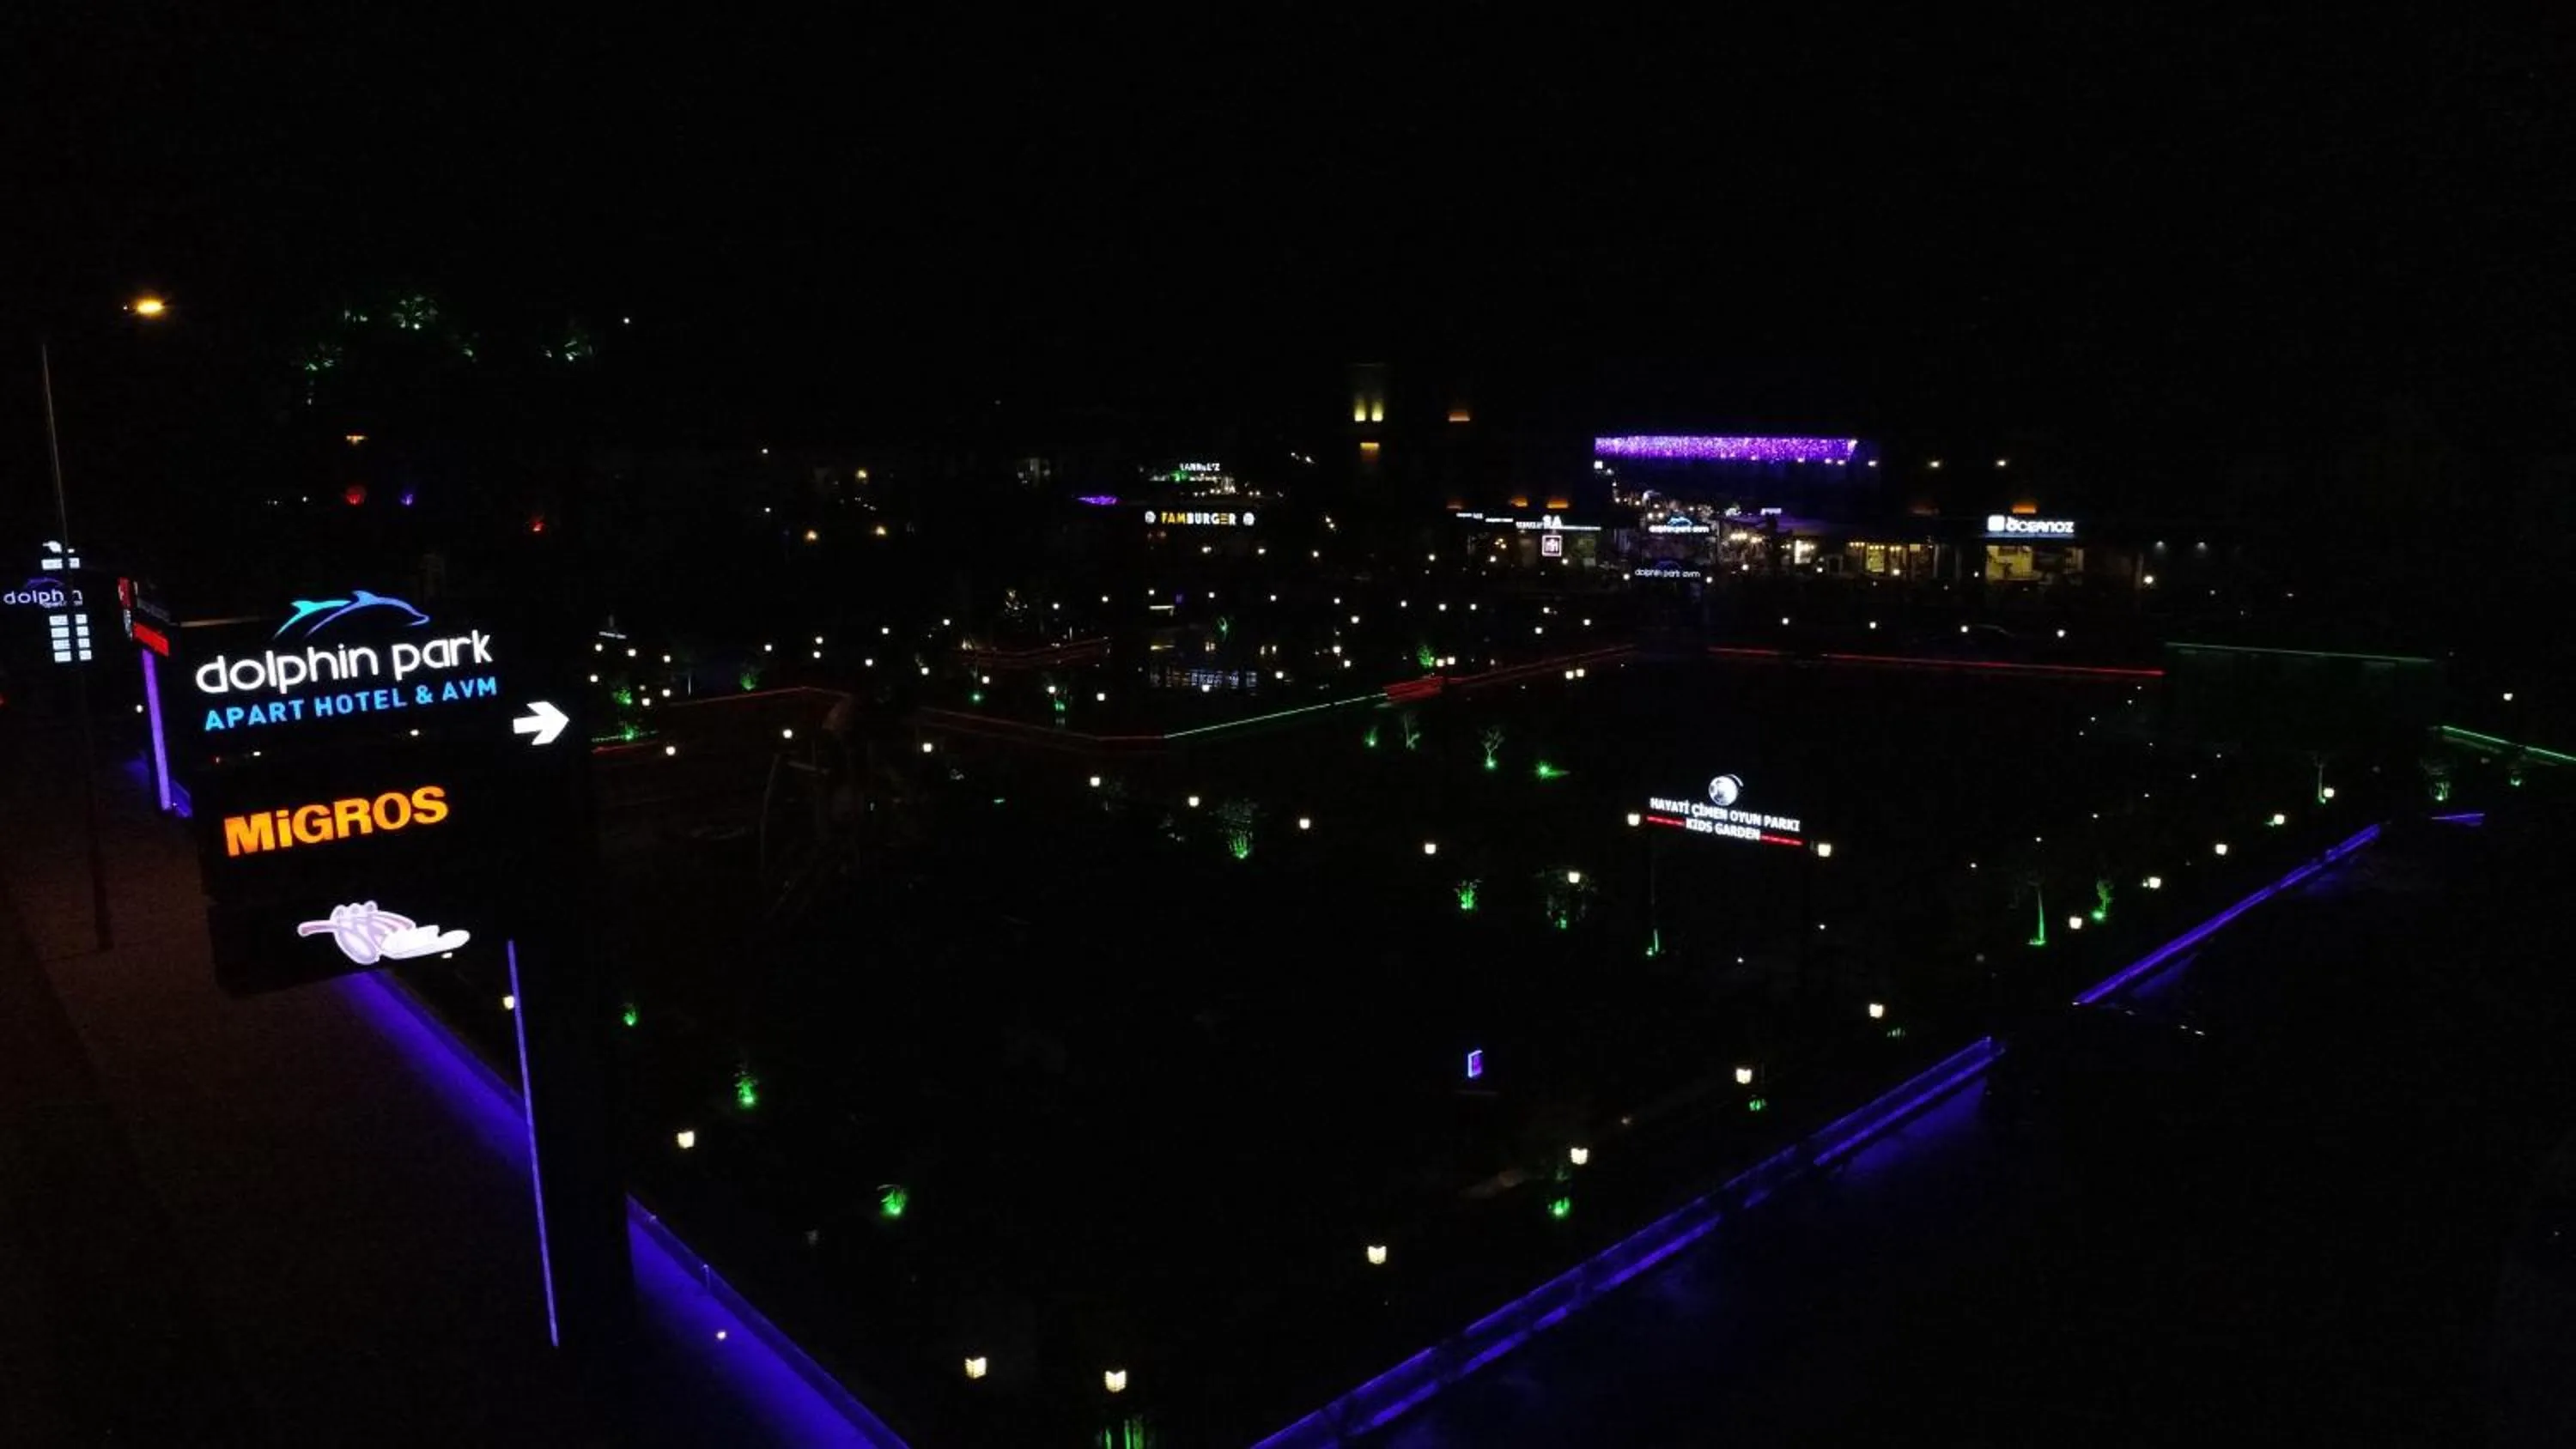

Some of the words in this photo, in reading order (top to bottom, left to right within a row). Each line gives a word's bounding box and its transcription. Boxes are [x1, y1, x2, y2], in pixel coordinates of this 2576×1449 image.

[1161, 512, 1236, 525] FAMBURGER
[195, 644, 379, 694] dolphin
[391, 629, 494, 682] park
[204, 699, 306, 731] APART
[313, 688, 407, 718] HOTEL
[415, 684, 434, 705] &
[441, 676, 497, 702] AVM
[1686, 818, 1713, 834] KIDS
[1715, 822, 1760, 840] GARDEN
[1729, 809, 1762, 826] OYUN
[1763, 815, 1801, 832] PARKI
